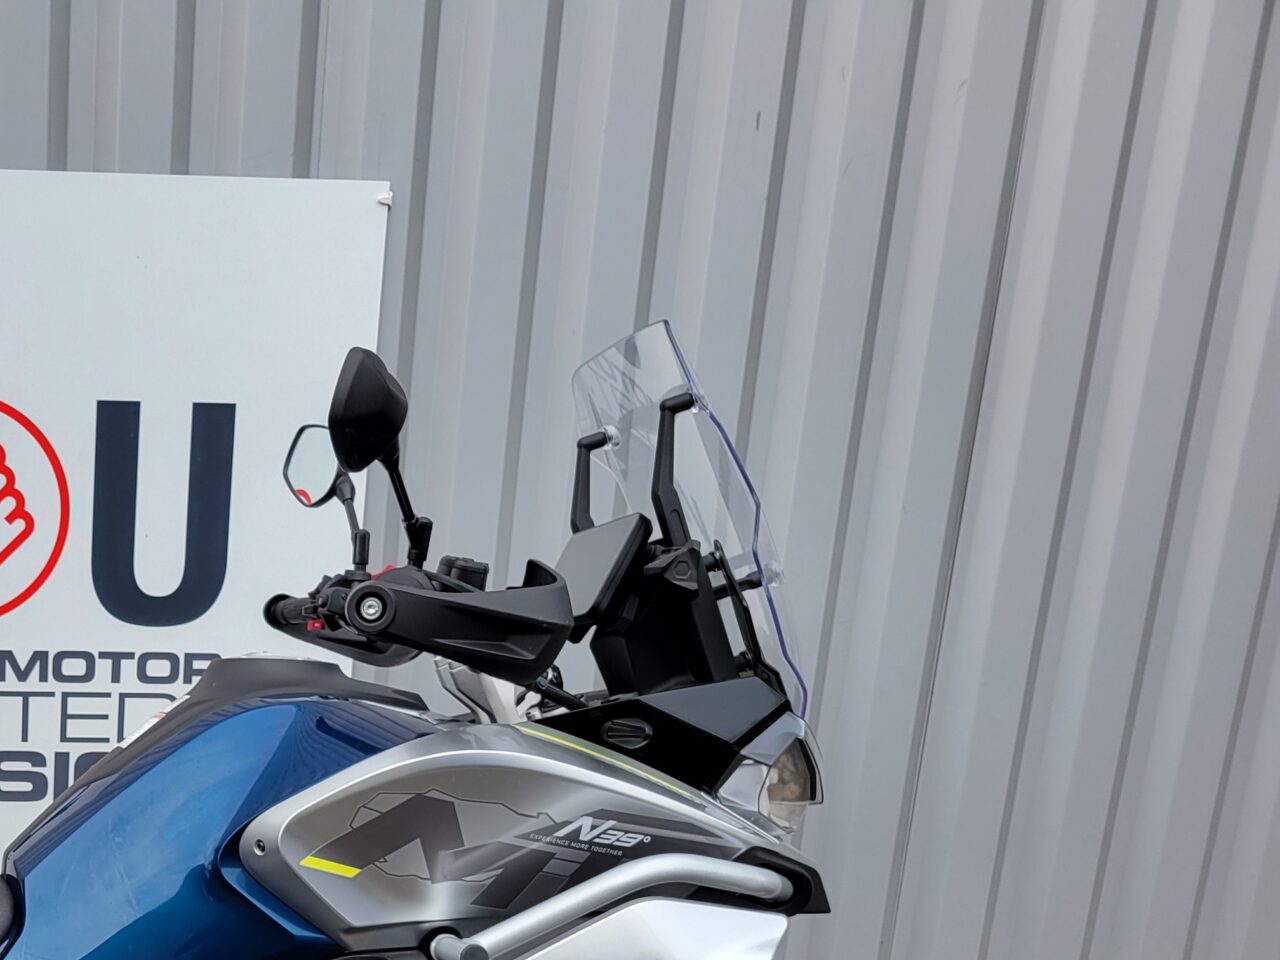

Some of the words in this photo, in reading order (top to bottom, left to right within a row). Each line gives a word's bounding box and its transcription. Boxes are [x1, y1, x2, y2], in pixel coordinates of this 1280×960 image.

[529, 833, 569, 847] EXPERIENCE
[570, 842, 590, 851] MORE
[590, 845, 623, 857] TOGETHER
